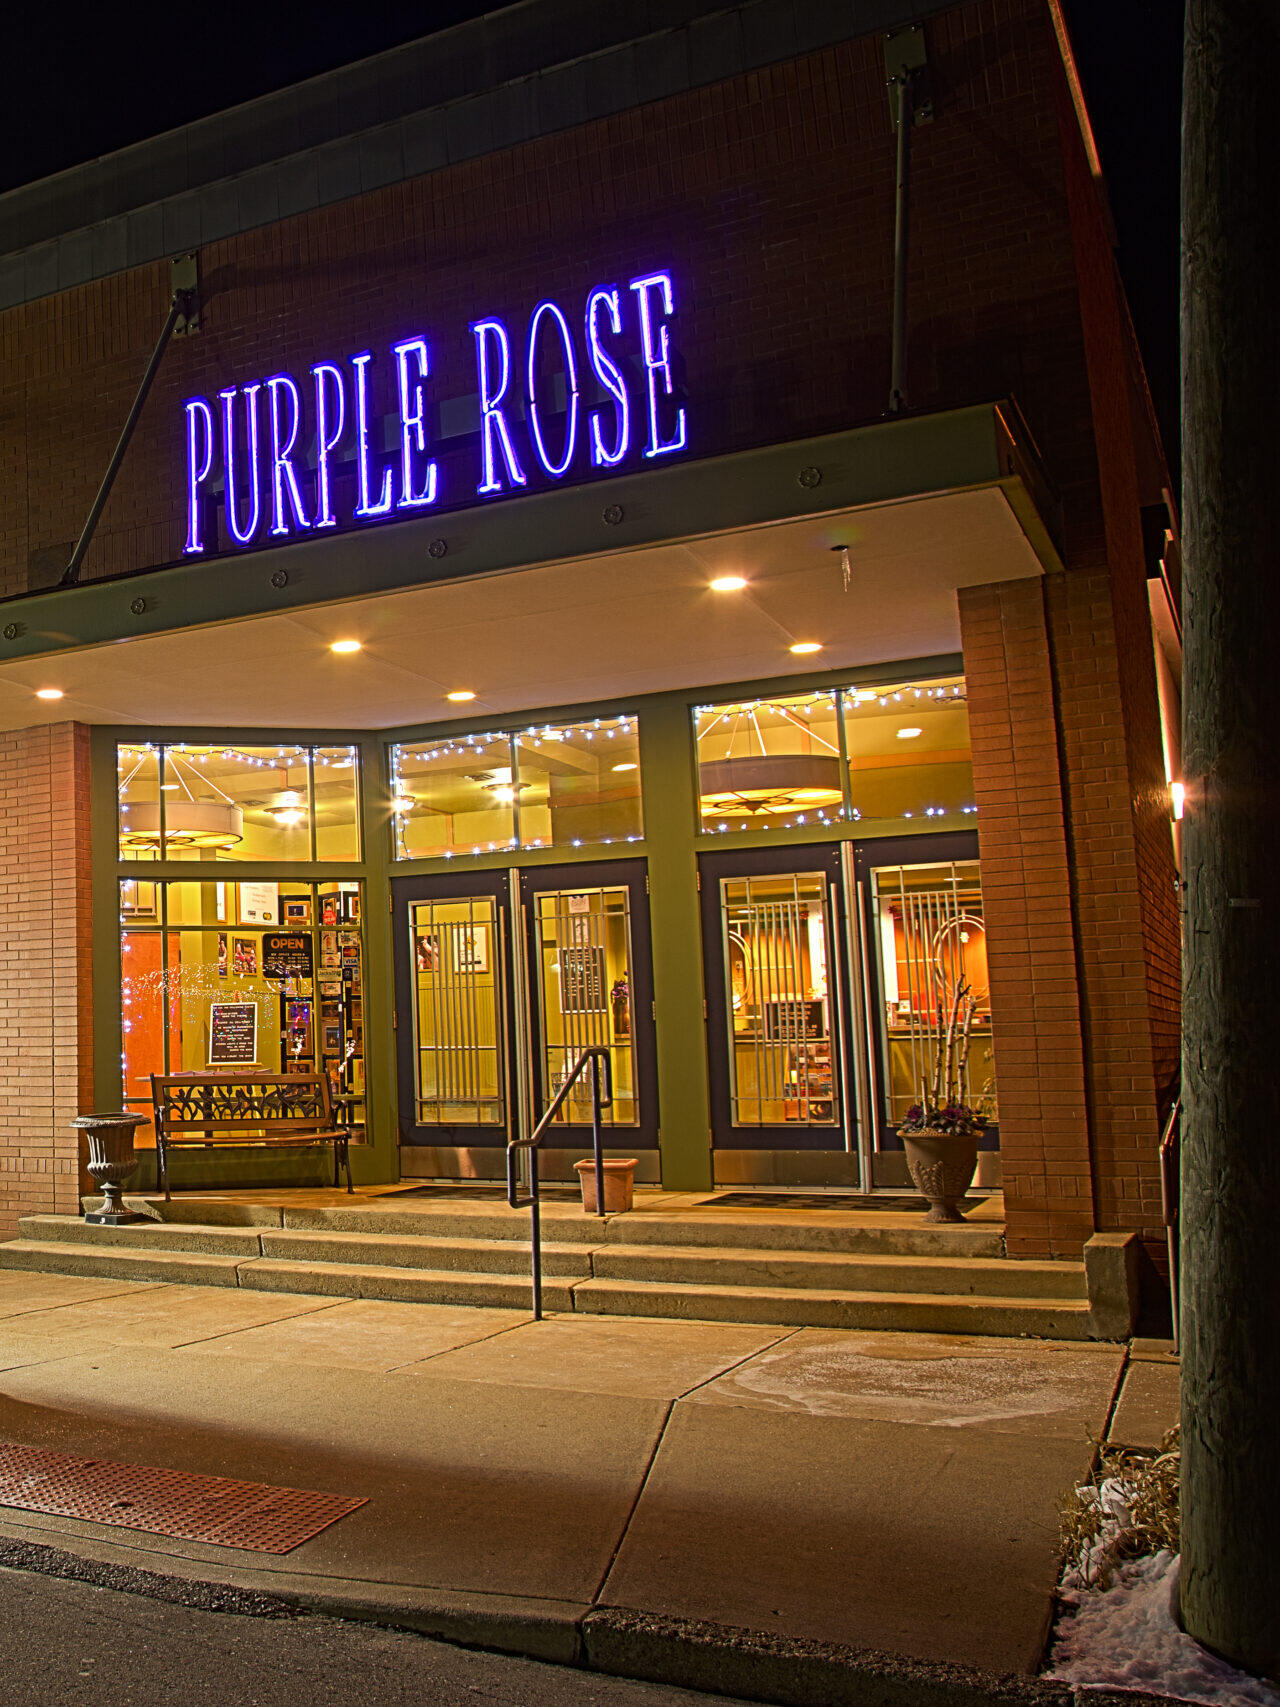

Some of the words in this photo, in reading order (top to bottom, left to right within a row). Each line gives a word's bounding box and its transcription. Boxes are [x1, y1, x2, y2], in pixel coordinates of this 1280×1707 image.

[183, 336, 438, 555] PURPLE
[470, 270, 688, 495] ROSE
[270, 938, 304, 949] OPEN
